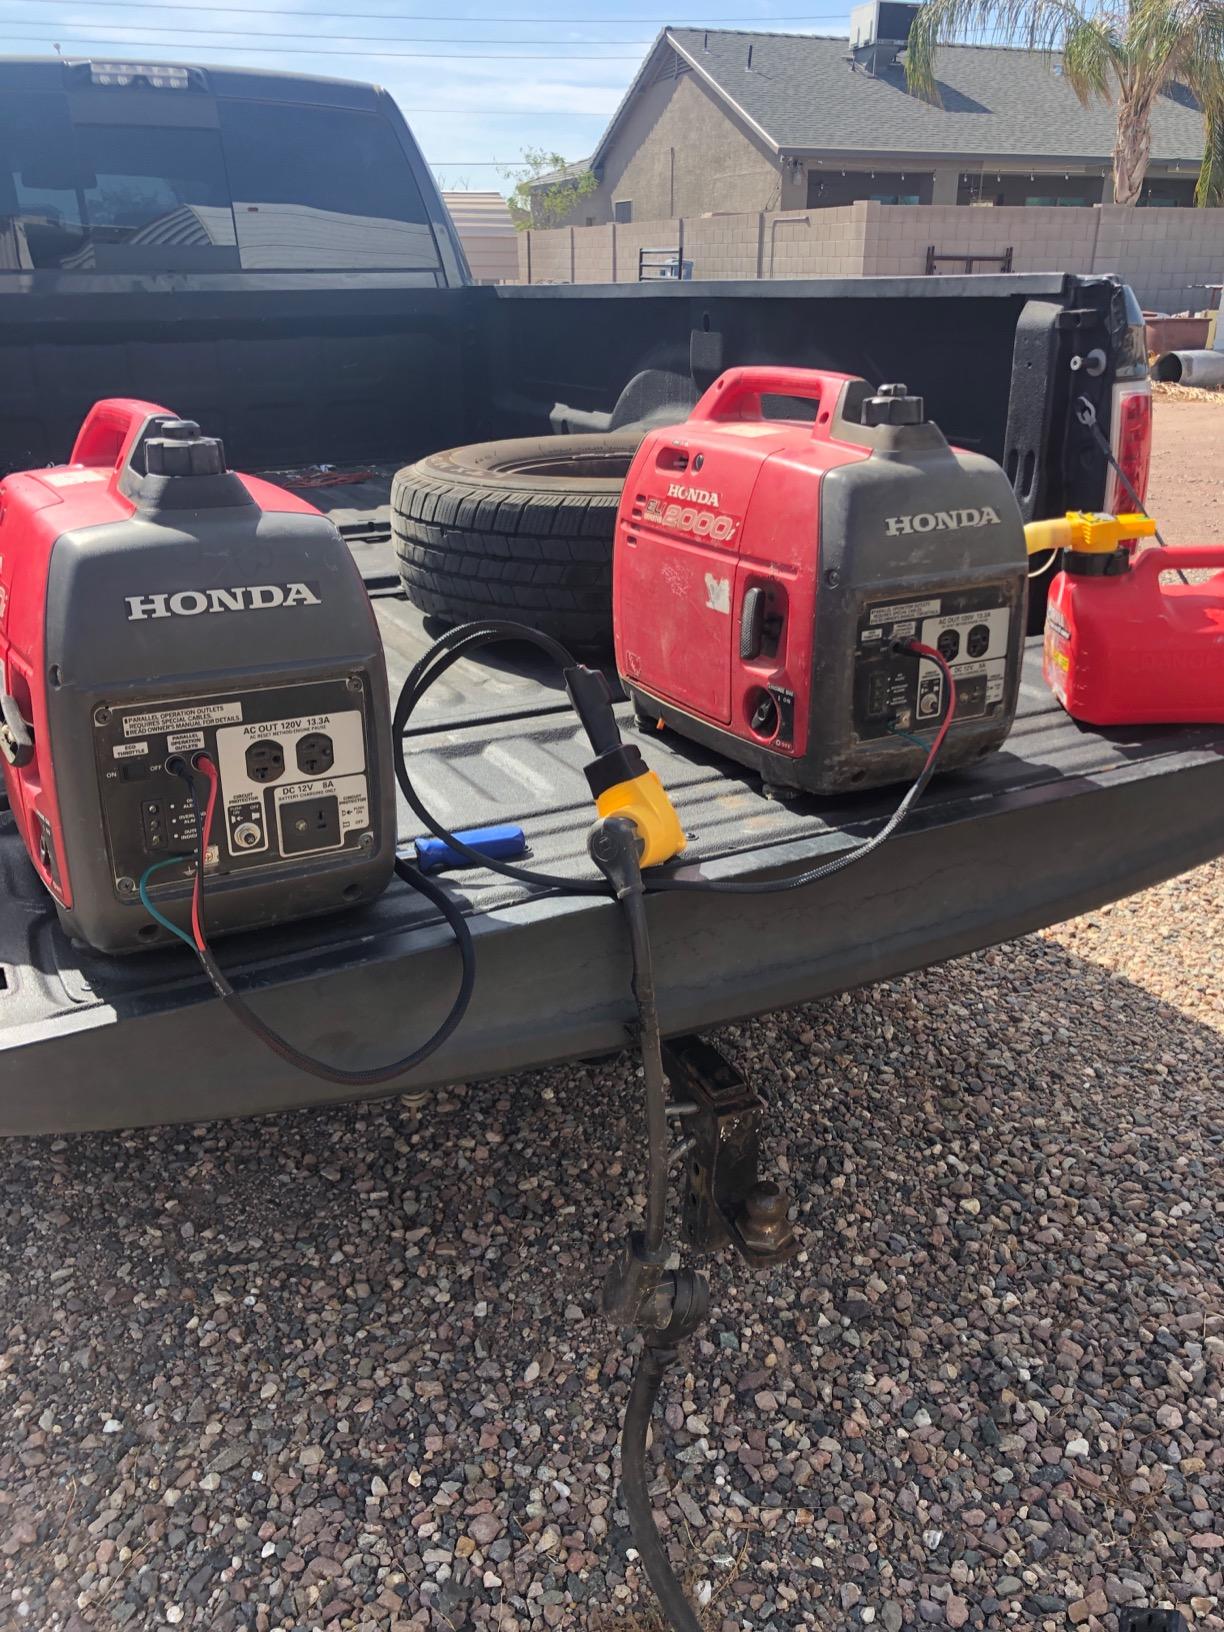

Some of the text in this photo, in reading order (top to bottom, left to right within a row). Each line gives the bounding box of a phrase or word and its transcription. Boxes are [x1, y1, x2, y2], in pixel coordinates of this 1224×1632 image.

[667, 484, 719, 507] HONDA
[885, 506, 1001, 536] HONDA
[125, 583, 321, 621] HONDA
[128, 706, 224, 723] PARALLEL OPERATION OUTLETS
[129, 721, 160, 730] REQUIRES
[161, 717, 186, 726] SPECIAL
[147, 725, 175, 733] OWNER'S
[176, 721, 202, 729] MANUAL
[215, 715, 240, 723] DETAILS
[243, 716, 330, 735] AC OUT 120V 13.3A
[171, 738, 201, 746] OPERATION
[172, 733, 198, 741] PARALLEL
[175, 743, 199, 751] OUTLETS
[282, 780, 334, 795] DC 12V 8A
